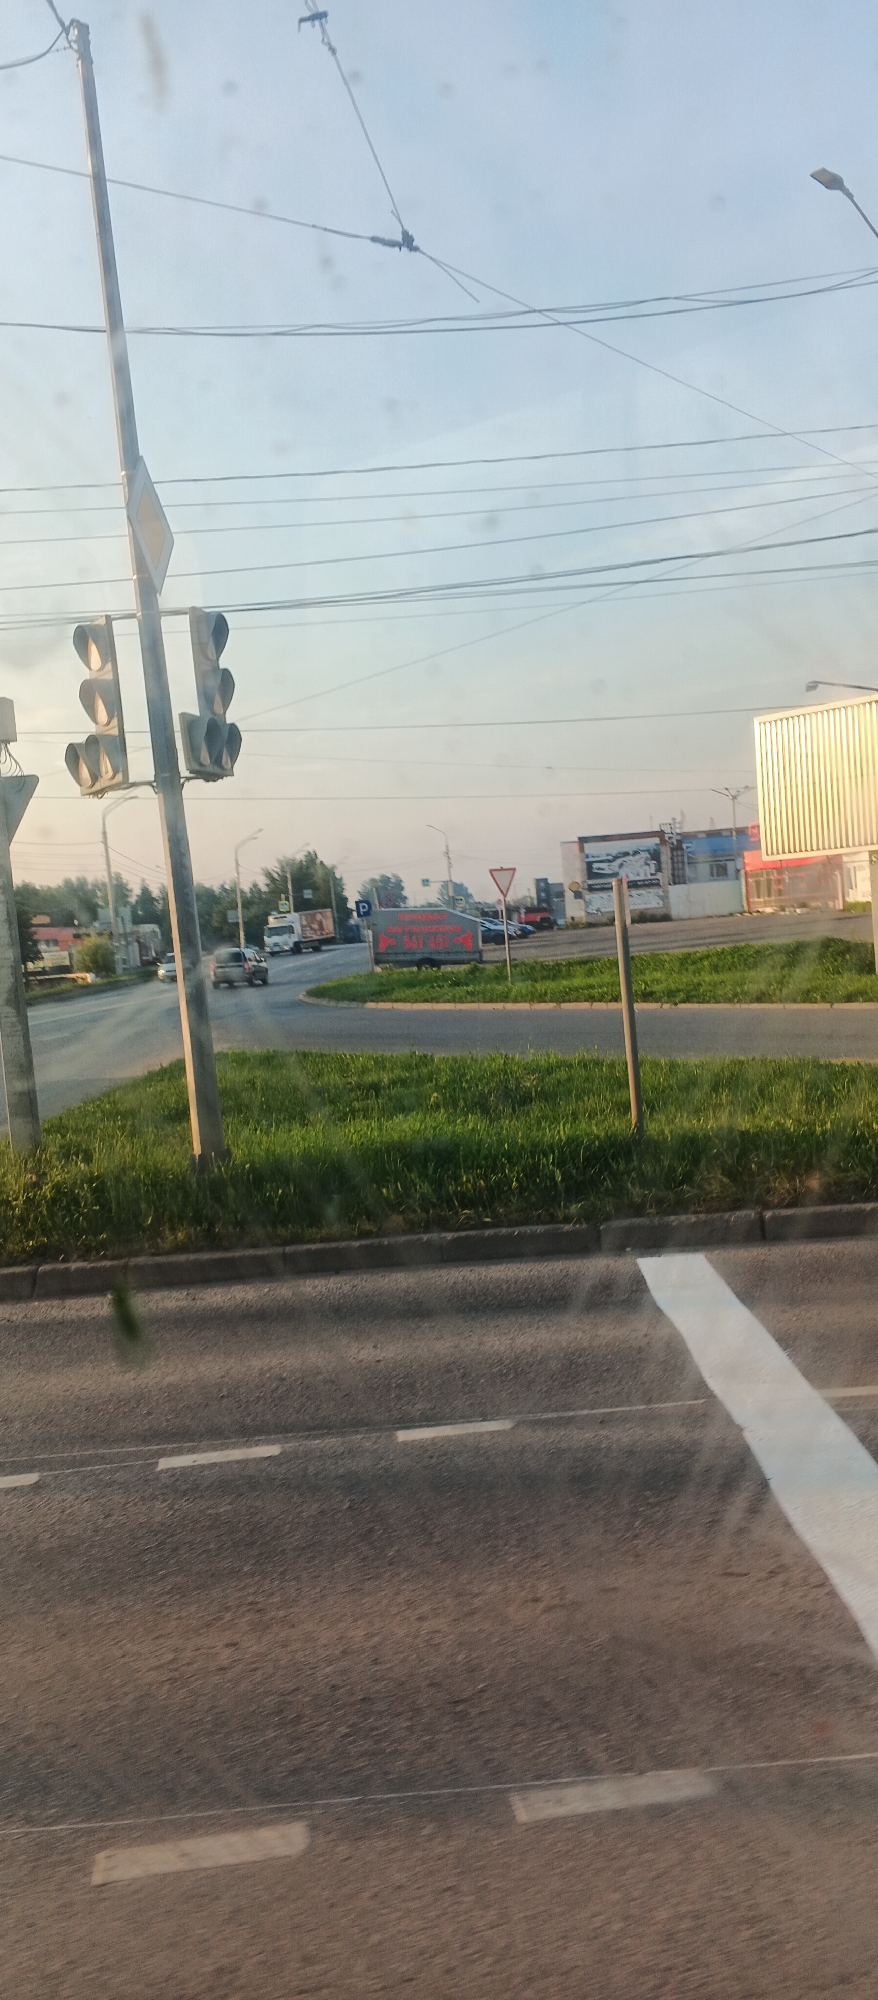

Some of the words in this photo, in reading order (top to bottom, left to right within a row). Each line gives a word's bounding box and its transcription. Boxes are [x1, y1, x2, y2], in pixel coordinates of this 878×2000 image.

[358, 902, 369, 915] P
[397, 912, 449, 922] ПРОКАТ
[403, 935, 449, 950] 561-651
